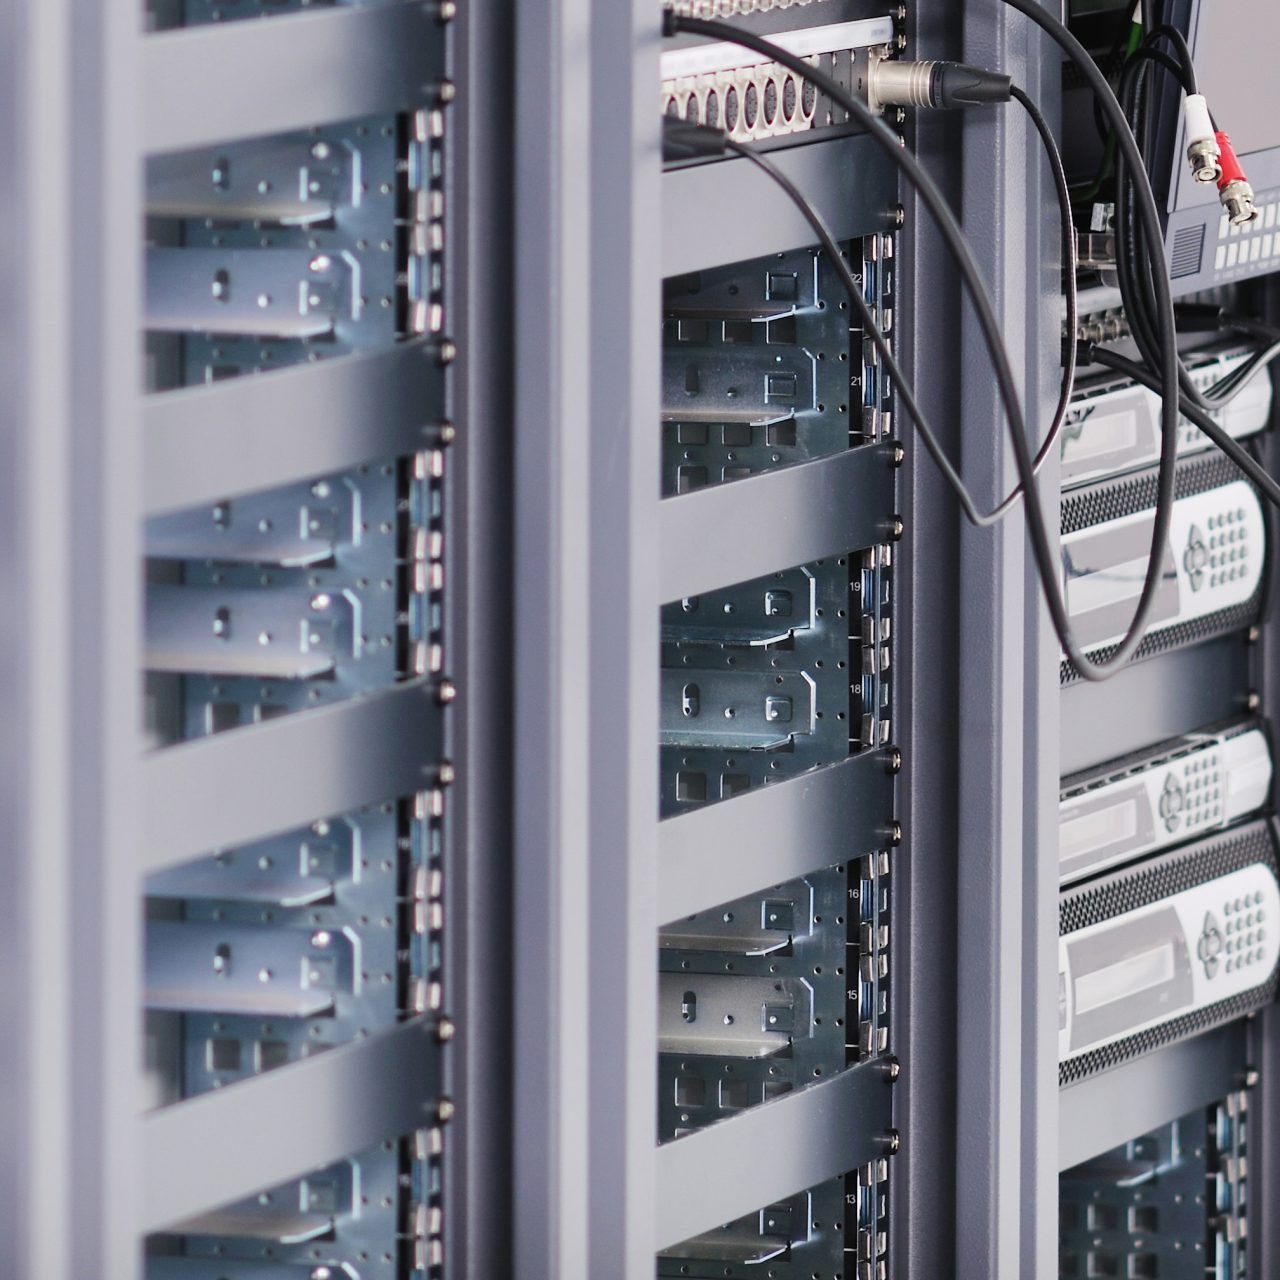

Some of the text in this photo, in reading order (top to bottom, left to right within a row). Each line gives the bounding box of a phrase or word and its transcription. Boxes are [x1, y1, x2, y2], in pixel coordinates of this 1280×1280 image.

[850, 377, 862, 386] 21
[849, 582, 861, 591] 19
[849, 684, 861, 694] 18
[848, 889, 859, 898] 16
[847, 990, 858, 1000] 15
[846, 1194, 856, 1204] 13
